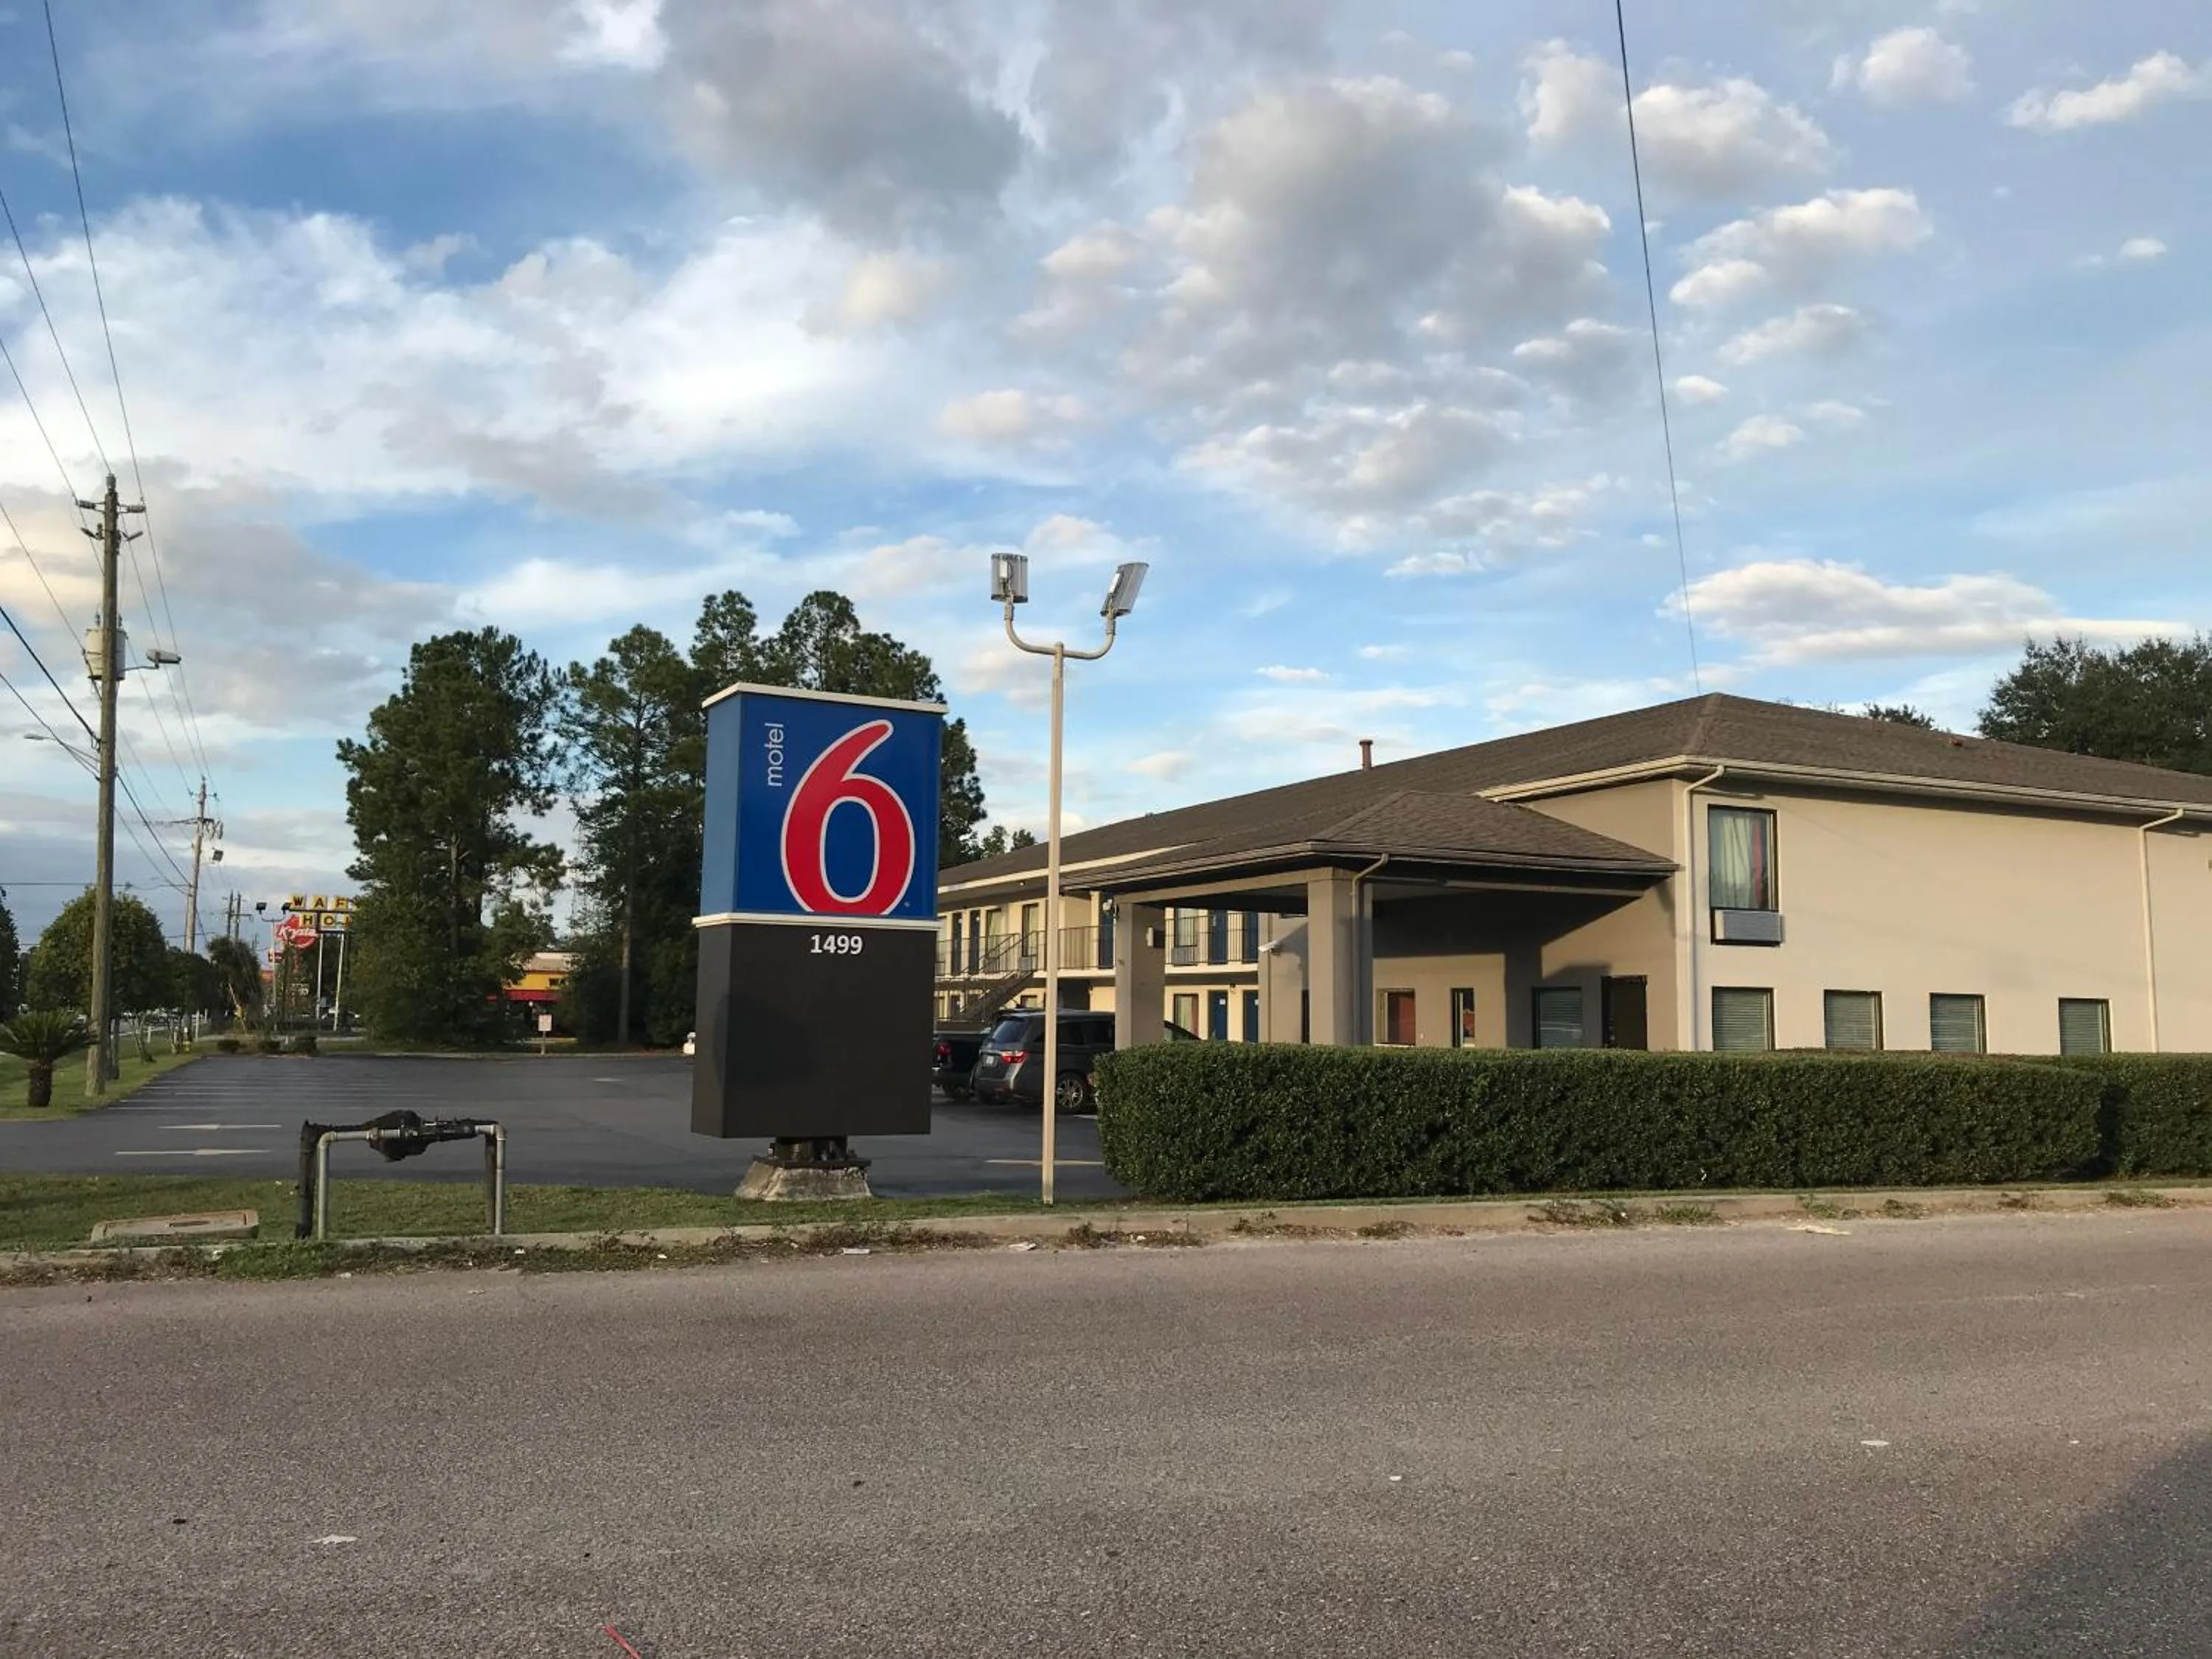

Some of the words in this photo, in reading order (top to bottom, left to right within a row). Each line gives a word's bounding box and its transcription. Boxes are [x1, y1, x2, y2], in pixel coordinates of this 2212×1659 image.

[765, 723, 784, 787] motel
[780, 719, 916, 915] 6
[293, 896, 350, 908] WAF
[278, 926, 319, 942] Krysta
[811, 934, 863, 955] 1499
